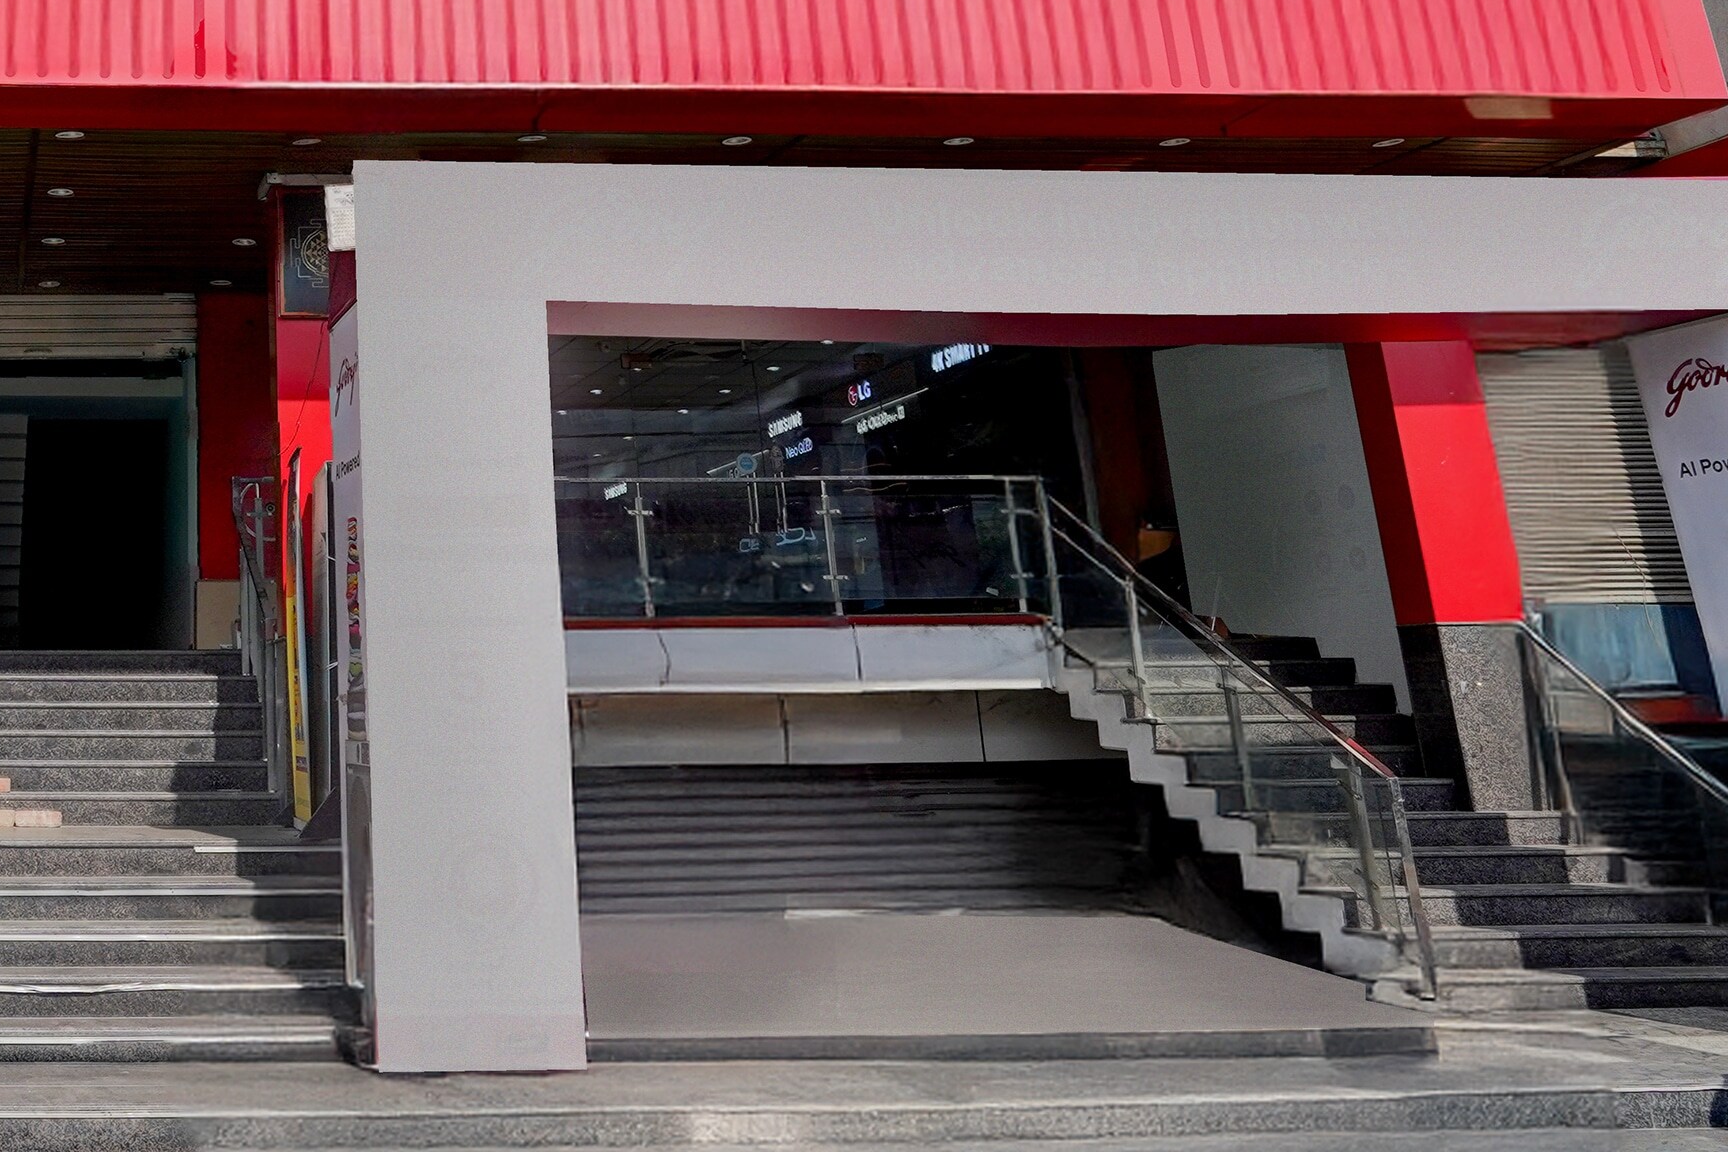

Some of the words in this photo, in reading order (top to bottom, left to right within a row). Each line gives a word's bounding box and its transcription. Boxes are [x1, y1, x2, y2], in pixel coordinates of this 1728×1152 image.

[857, 380, 872, 401] LG
[768, 410, 803, 438] SAMSUNG
[1680, 460, 1697, 479] AI
